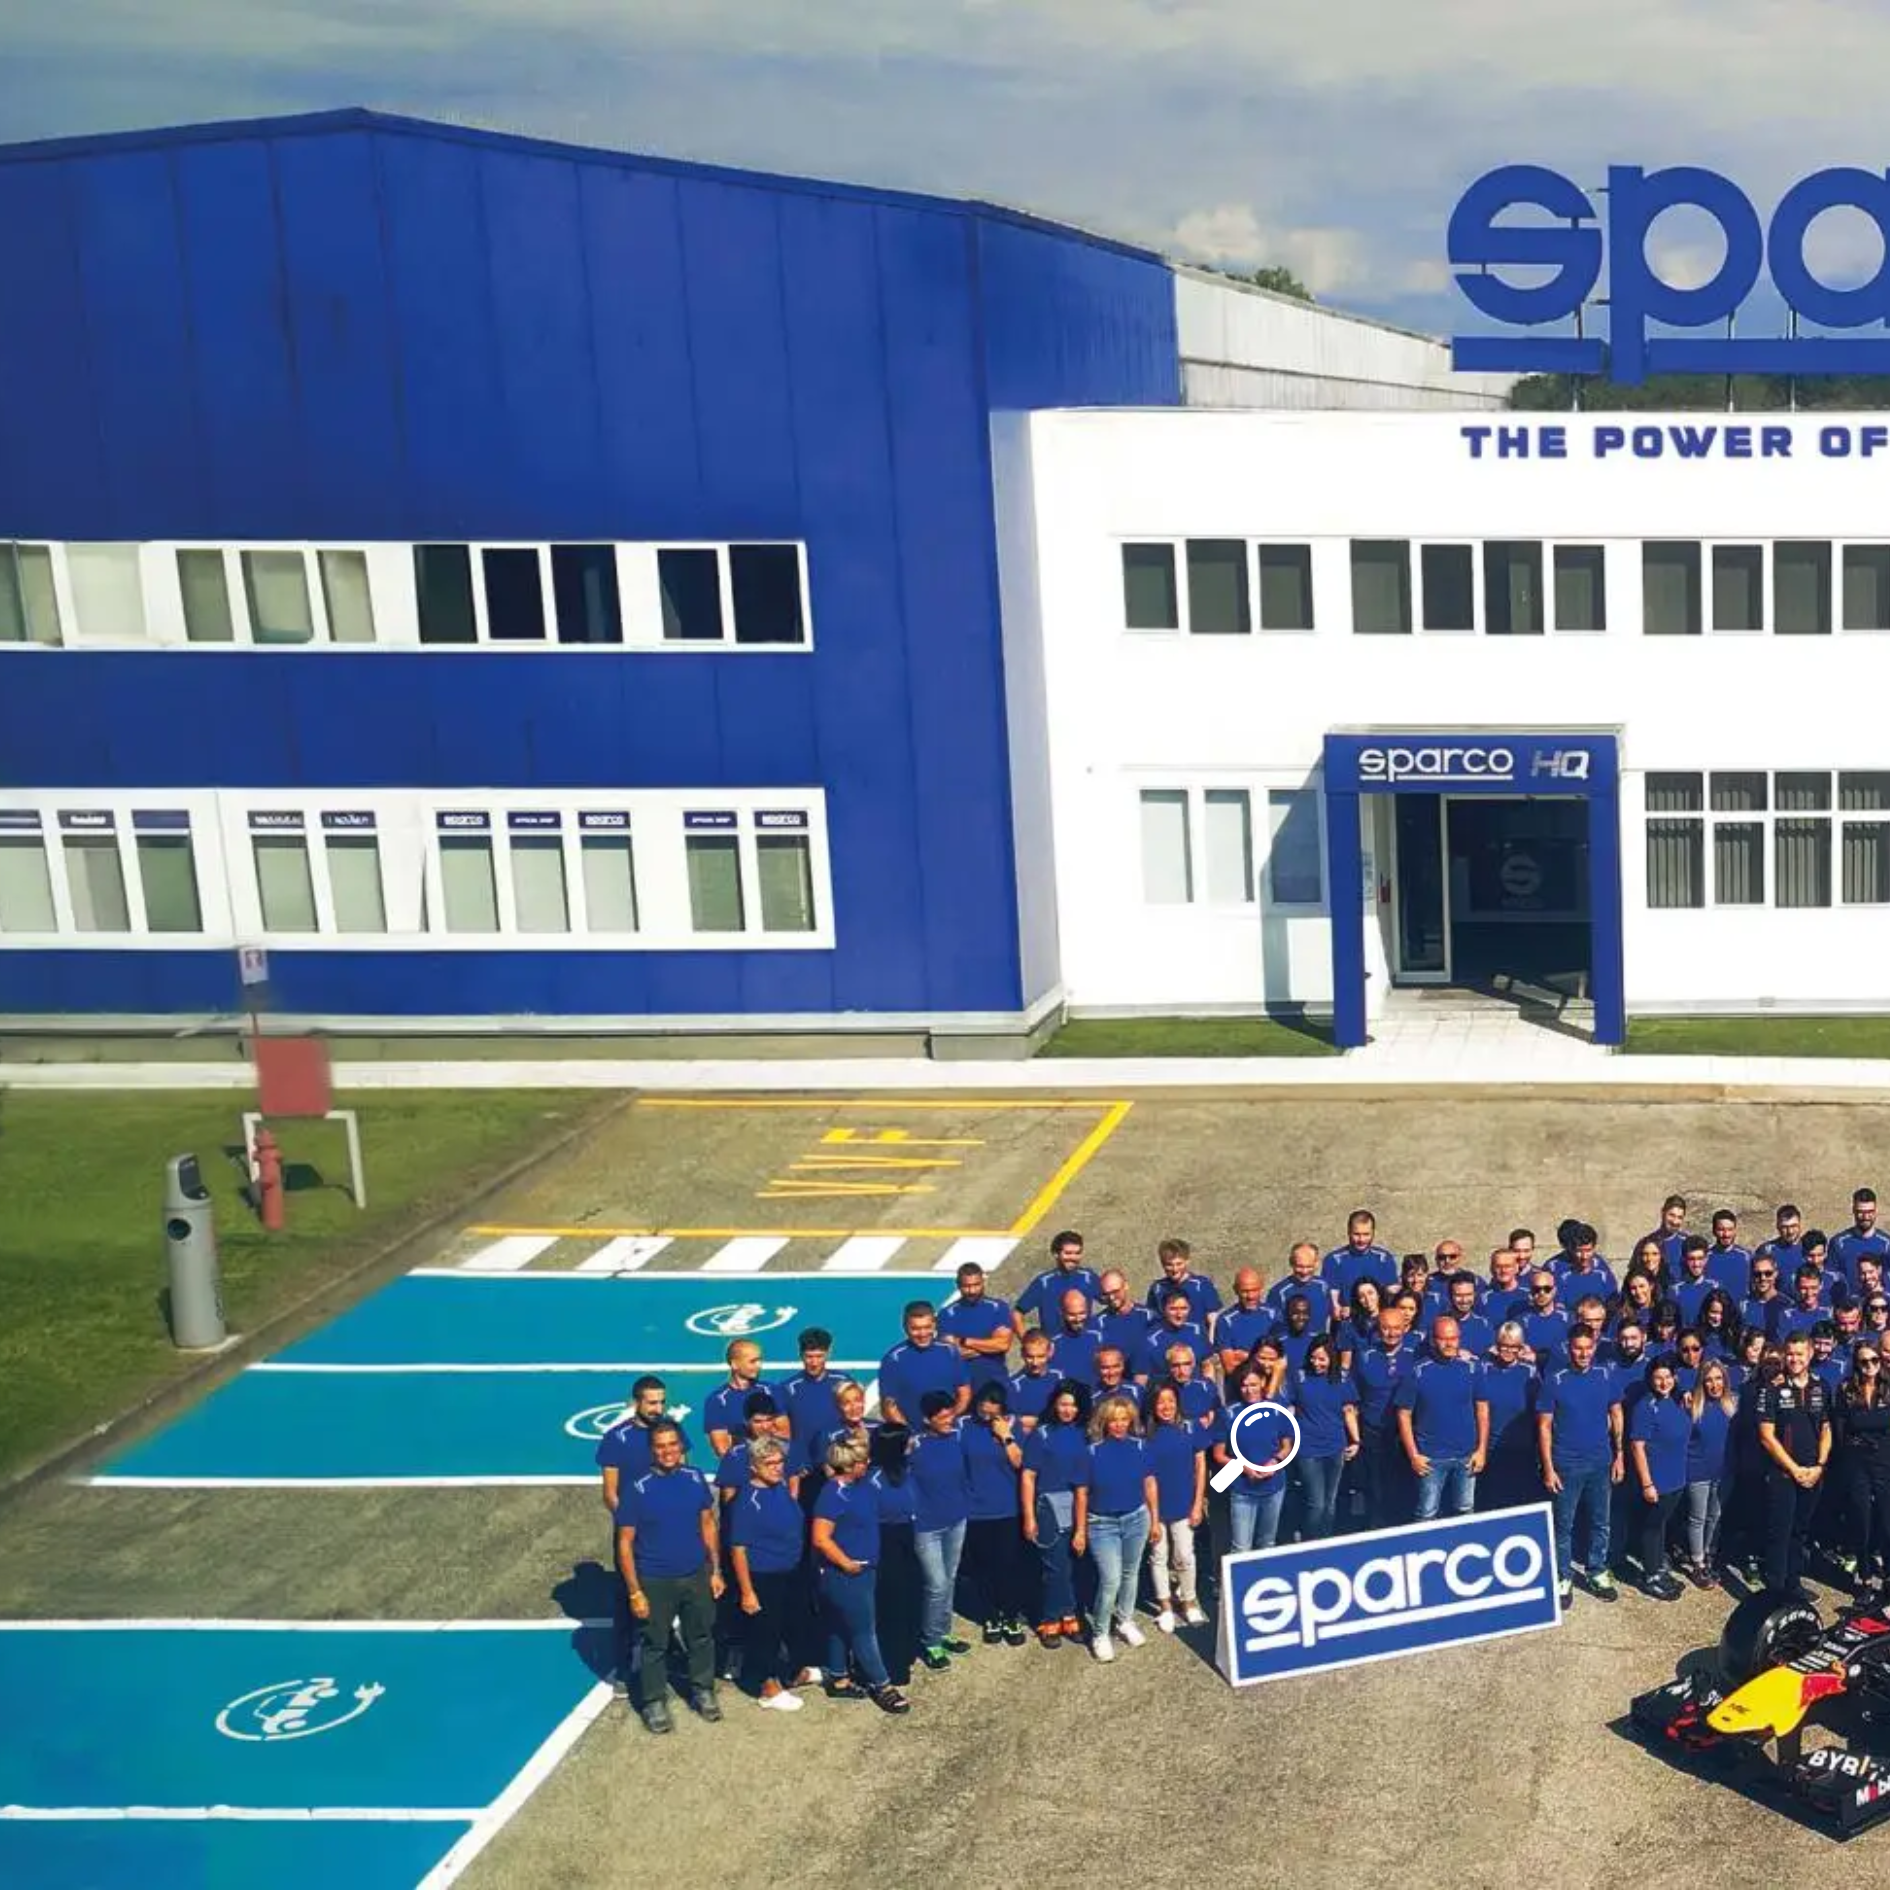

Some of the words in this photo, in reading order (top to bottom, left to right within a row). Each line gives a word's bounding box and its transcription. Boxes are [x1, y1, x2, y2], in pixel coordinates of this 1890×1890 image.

[1460, 425, 1568, 459] THE
[1594, 425, 1794, 459] POWER
[1819, 425, 1889, 459] OF
[1359, 748, 1514, 782] sparco
[1531, 750, 1590, 780] HQ
[1243, 1534, 1543, 1648] sparco
